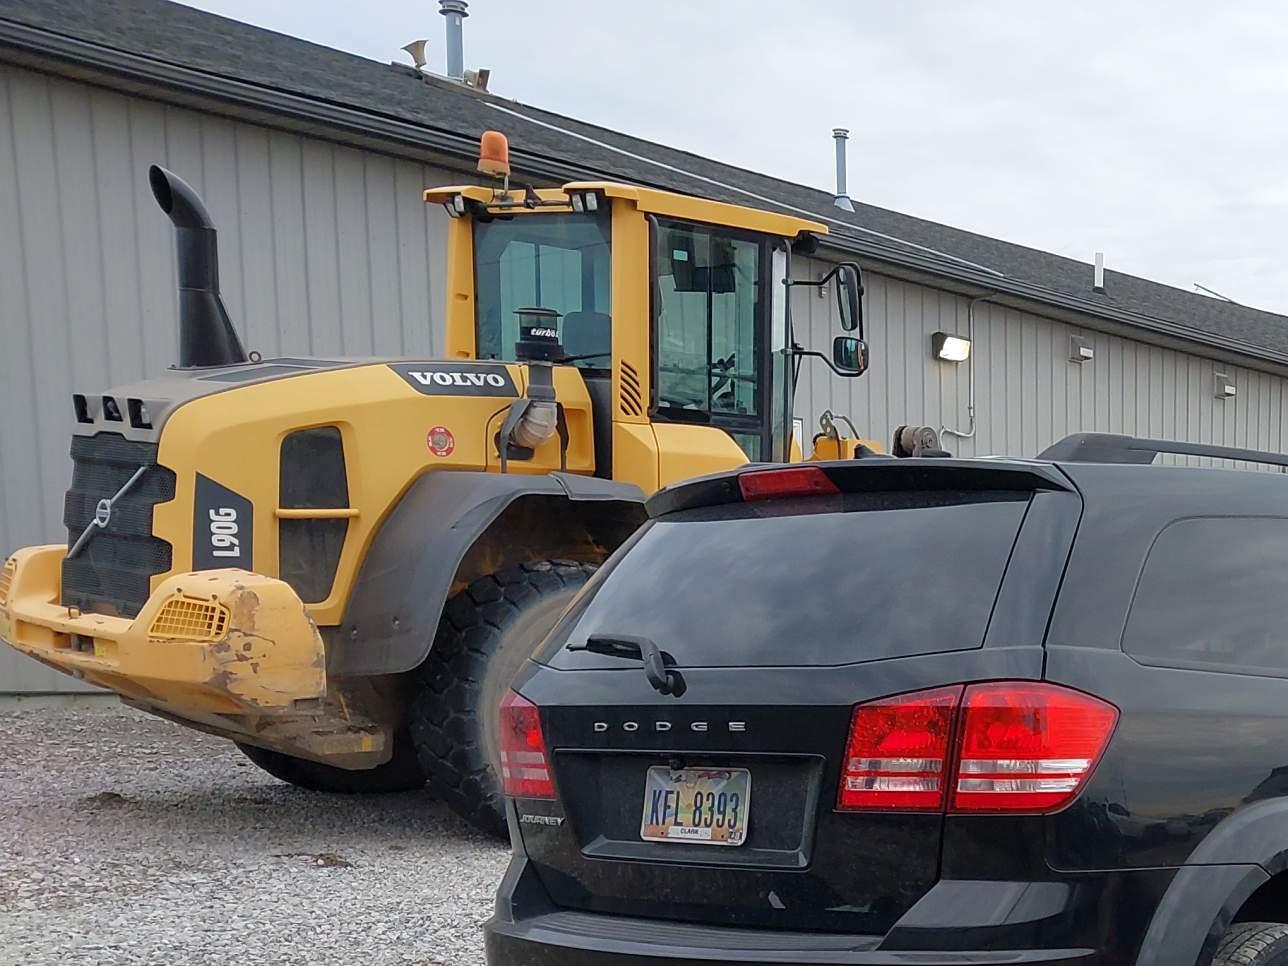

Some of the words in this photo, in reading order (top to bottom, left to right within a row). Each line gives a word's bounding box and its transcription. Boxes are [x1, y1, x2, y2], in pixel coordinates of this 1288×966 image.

[408, 371, 505, 387] VOLVO
[209, 507, 240, 557] L90G
[593, 721, 747, 732] DODGE
[650, 789, 684, 827] KFL
[692, 791, 740, 830] 8393
[519, 814, 566, 827] JOURNEY
